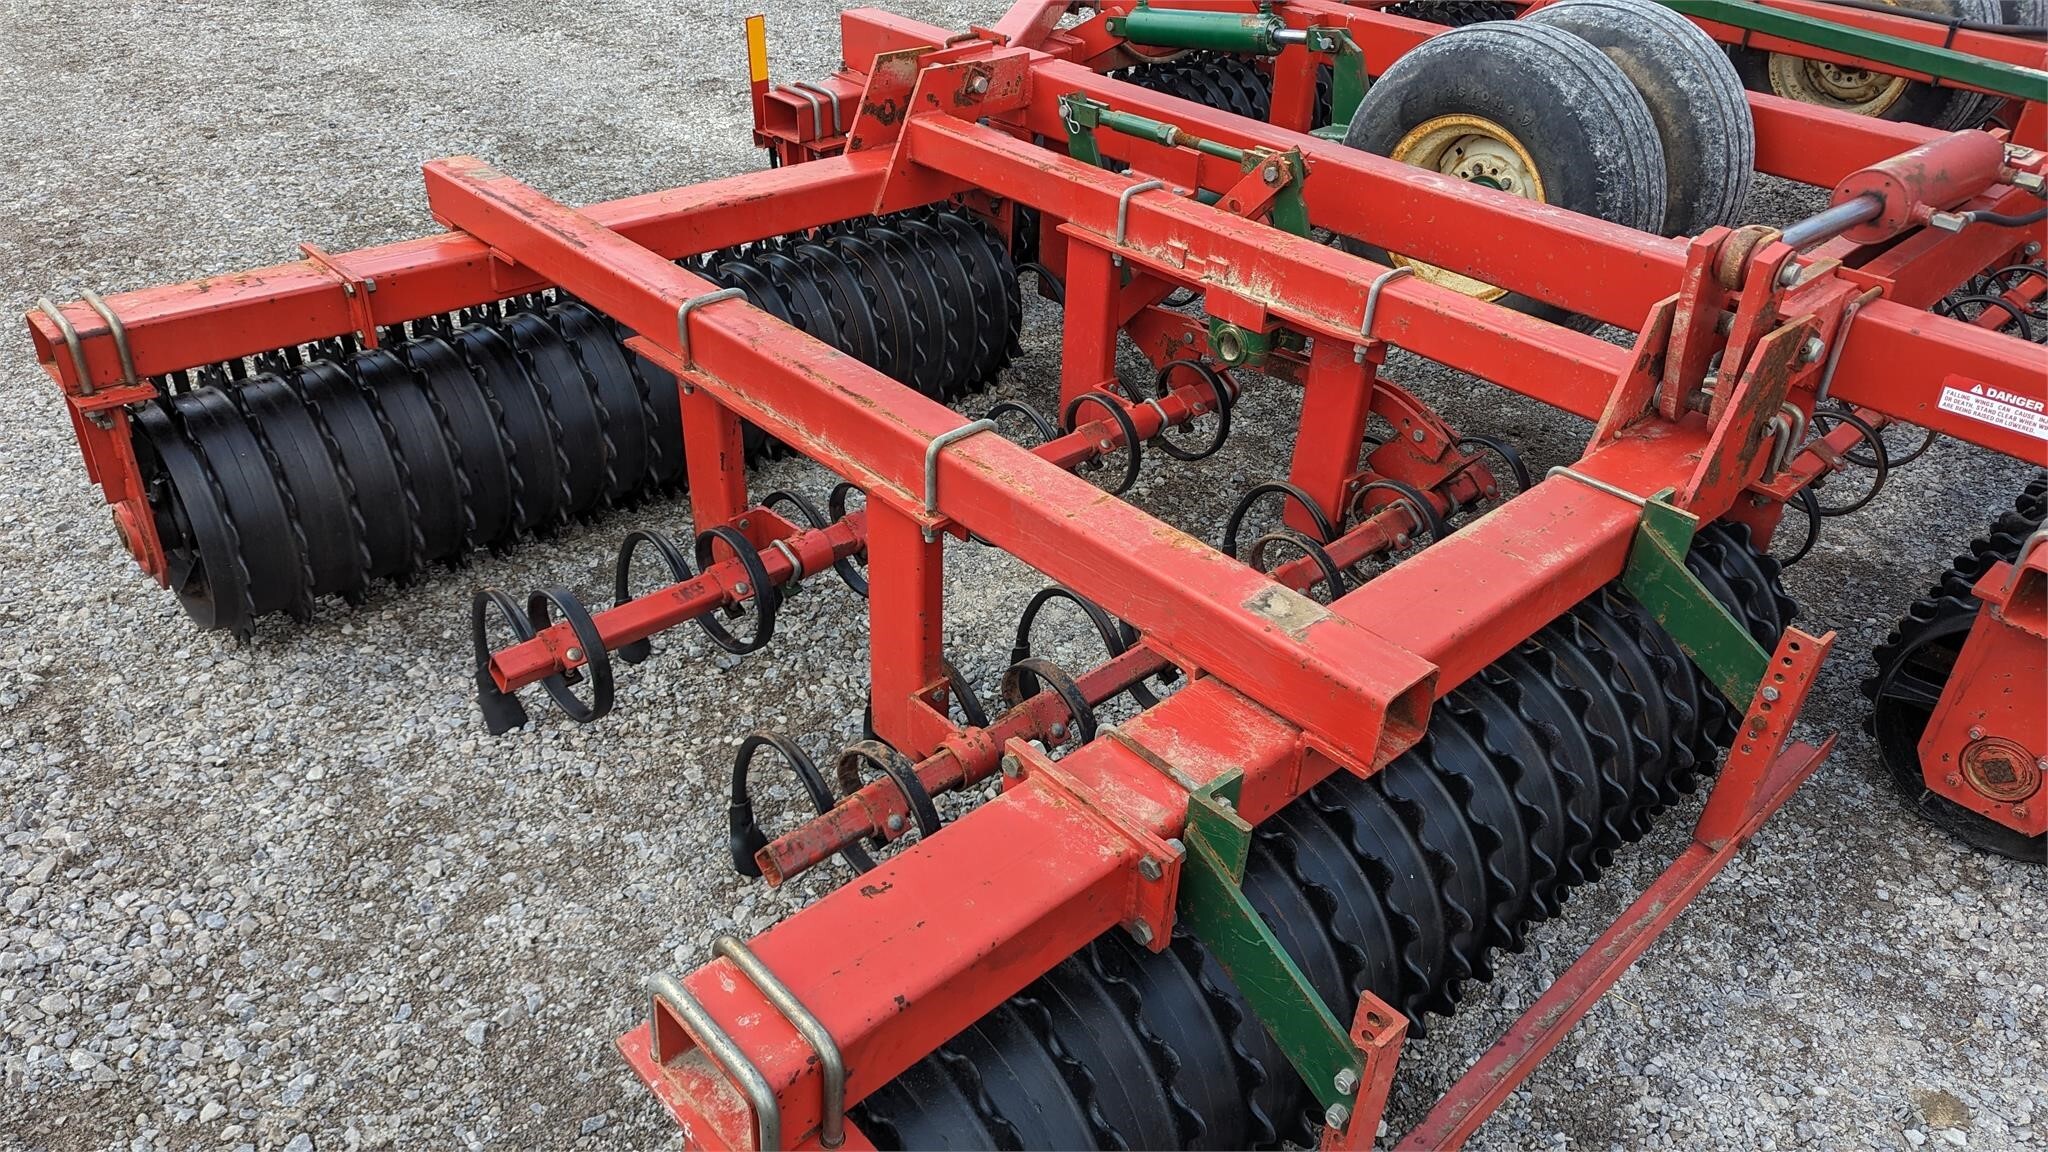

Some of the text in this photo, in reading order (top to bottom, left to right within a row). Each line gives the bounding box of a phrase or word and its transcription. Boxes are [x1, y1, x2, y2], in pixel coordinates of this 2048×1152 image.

[1407, 86, 1515, 115] Frestone
[1942, 402, 1953, 410] ARE
[1954, 405, 1972, 415] BEING
[1972, 411, 1995, 421] RAISED
[1995, 417, 2004, 425] OR
[1944, 395, 1952, 403] OR
[1976, 405, 1997, 415] STAND
[1997, 411, 2018, 422] CLEAR
[2019, 418, 2038, 427] WHEN
[1946, 389, 1971, 401] FALLING
[1975, 398, 1994, 408] WINGS
[1997, 403, 2011, 413] CAN
[2014, 409, 2035, 420] CAUSE
[1986, 388, 2044, 412] DANGER
